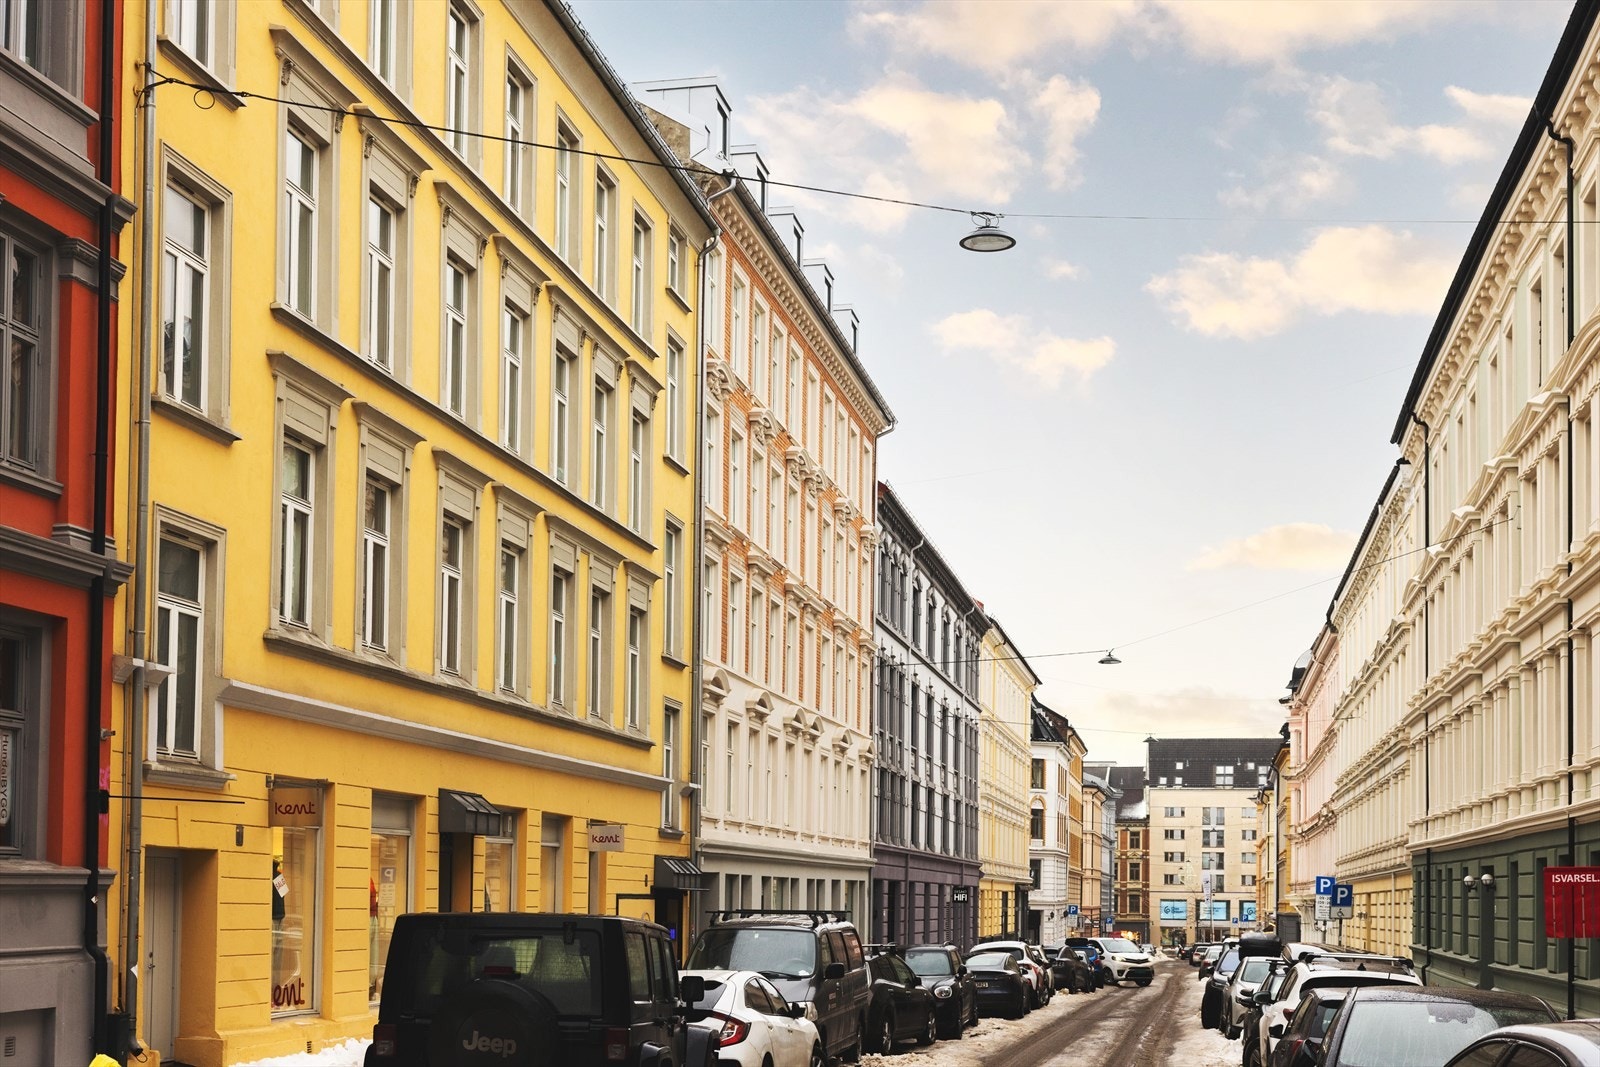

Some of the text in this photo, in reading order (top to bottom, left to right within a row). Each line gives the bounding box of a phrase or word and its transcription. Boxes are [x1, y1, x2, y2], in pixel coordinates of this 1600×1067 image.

[274, 801, 316, 815] kent
[591, 834, 620, 843] kent
[1320, 878, 1331, 893] P
[1336, 887, 1349, 905] P
[1070, 906, 1077, 914] P
[462, 1030, 517, 1058] Jeep
